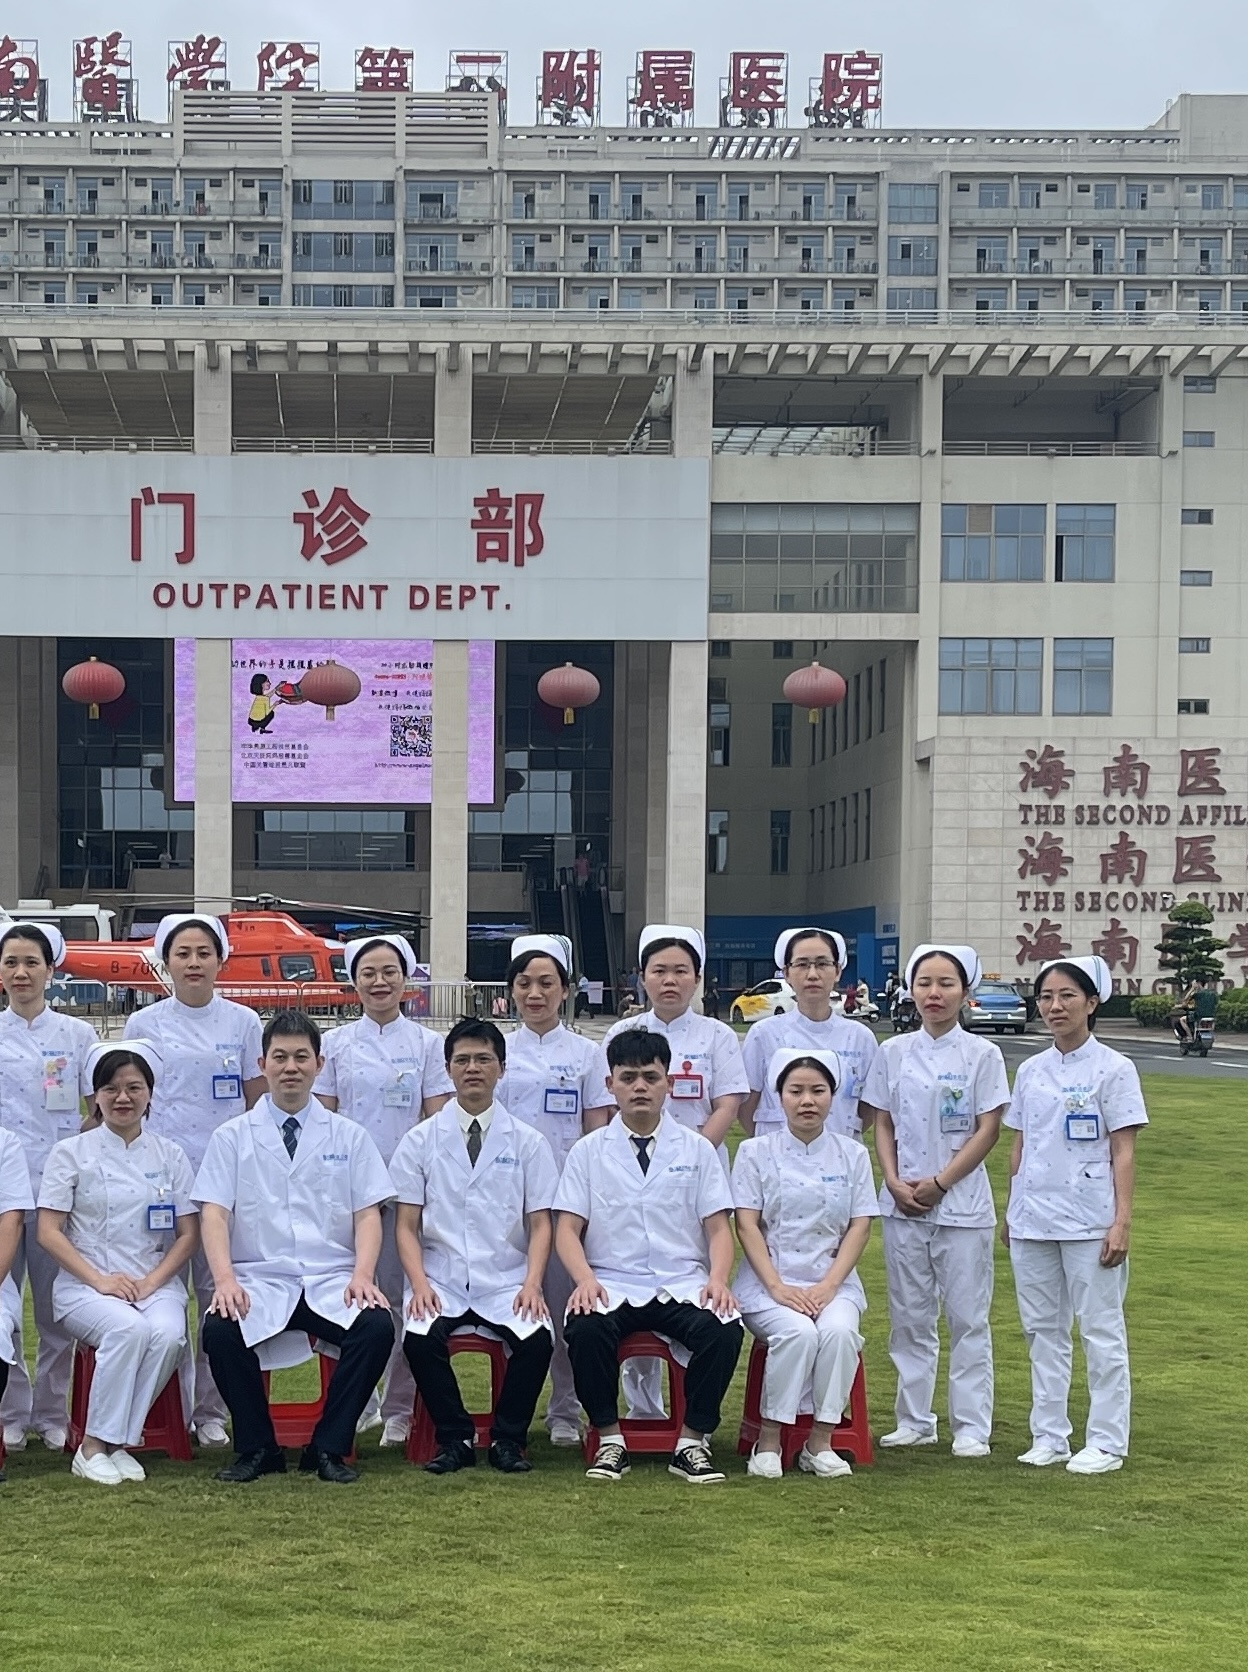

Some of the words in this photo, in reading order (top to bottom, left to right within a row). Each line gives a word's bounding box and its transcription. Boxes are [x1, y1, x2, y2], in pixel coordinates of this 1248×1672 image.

[130, 487, 545, 567] 门诊部
[153, 582, 389, 611] OUTPATIENT
[409, 583, 511, 611] DEPT.
[1019, 744, 1227, 799] 海南医
[1018, 804, 1065, 825] THE
[1075, 804, 1171, 826] SECOND
[1178, 804, 1248, 826] AFFIL
[1017, 831, 1223, 887] 海南医
[1017, 890, 1065, 912] THE
[1074, 891, 1176, 912] SECOND
[1186, 892, 1248, 912] LIN
